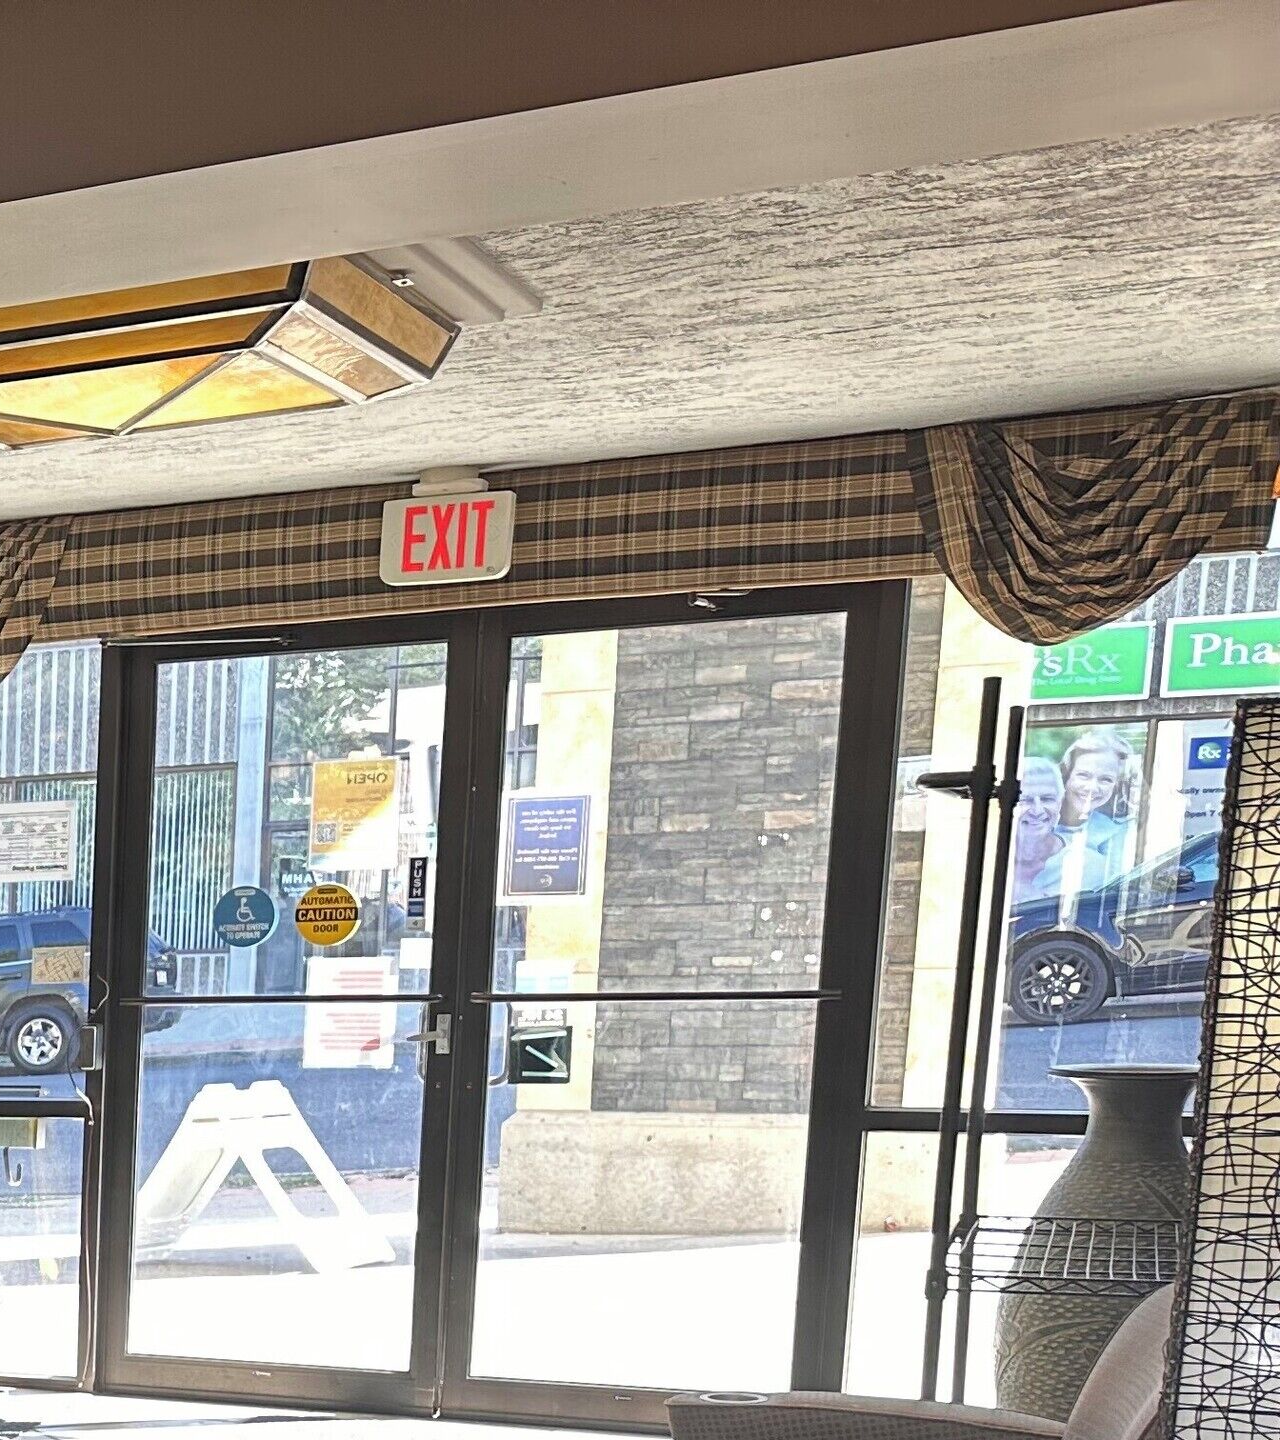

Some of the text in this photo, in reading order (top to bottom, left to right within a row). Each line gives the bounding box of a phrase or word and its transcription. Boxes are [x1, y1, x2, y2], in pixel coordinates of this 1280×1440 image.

[401, 500, 496, 573] EXIT
[1185, 632, 1280, 669] Pha
[412, 859, 424, 898] PUSH
[300, 896, 354, 905] AUTOMATIC
[298, 908, 356, 921] CAUTION
[312, 924, 339, 933] DOOR
